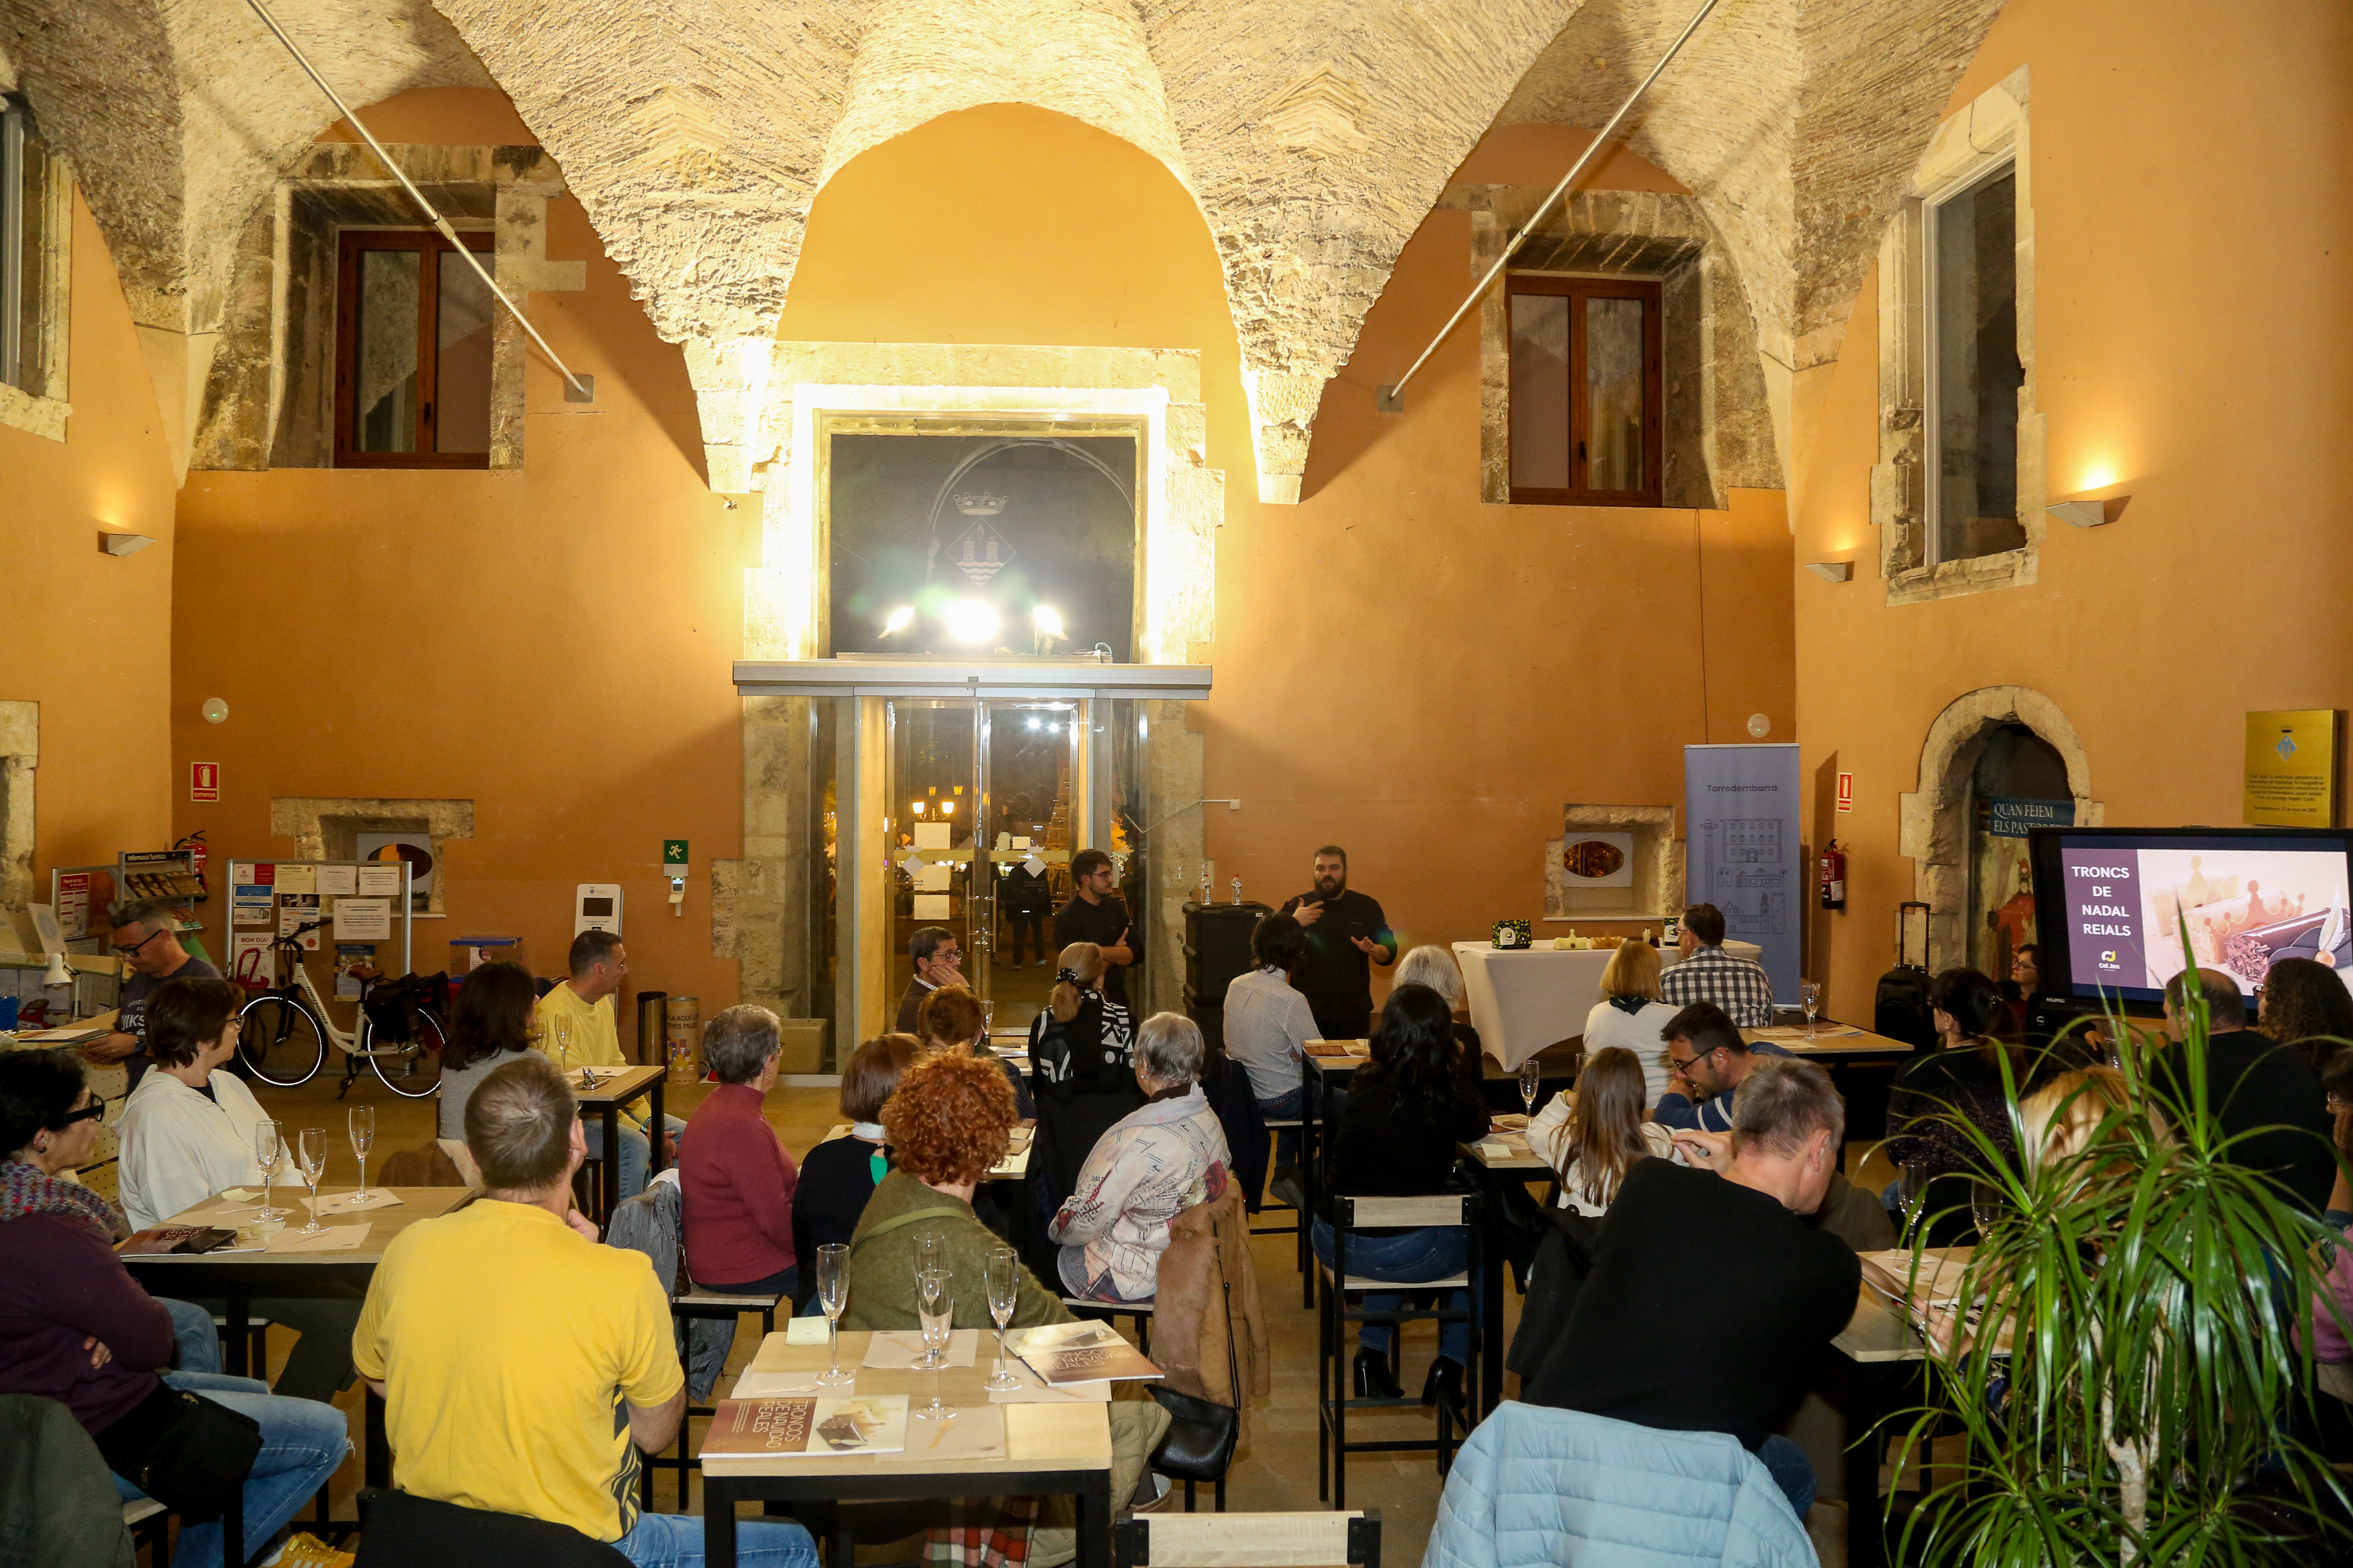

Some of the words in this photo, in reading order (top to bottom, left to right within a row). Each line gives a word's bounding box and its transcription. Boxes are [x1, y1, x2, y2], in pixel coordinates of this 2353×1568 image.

[1995, 803, 2022, 819] QUAN
[1994, 820, 2009, 833] ELS
[2071, 866, 2130, 878] TRONCS
[2092, 886, 2112, 897] DE
[2082, 905, 2130, 917] NADAL
[2083, 923, 2131, 936] REIALS
[1062, 1352, 1131, 1363] NAVIDAD
[1053, 1360, 1105, 1370] EALES
[775, 1401, 792, 1411] DE
[752, 1401, 775, 1433] REALES
[785, 1400, 809, 1442] TRONCOS
[766, 1413, 788, 1448] NAVIDAD
